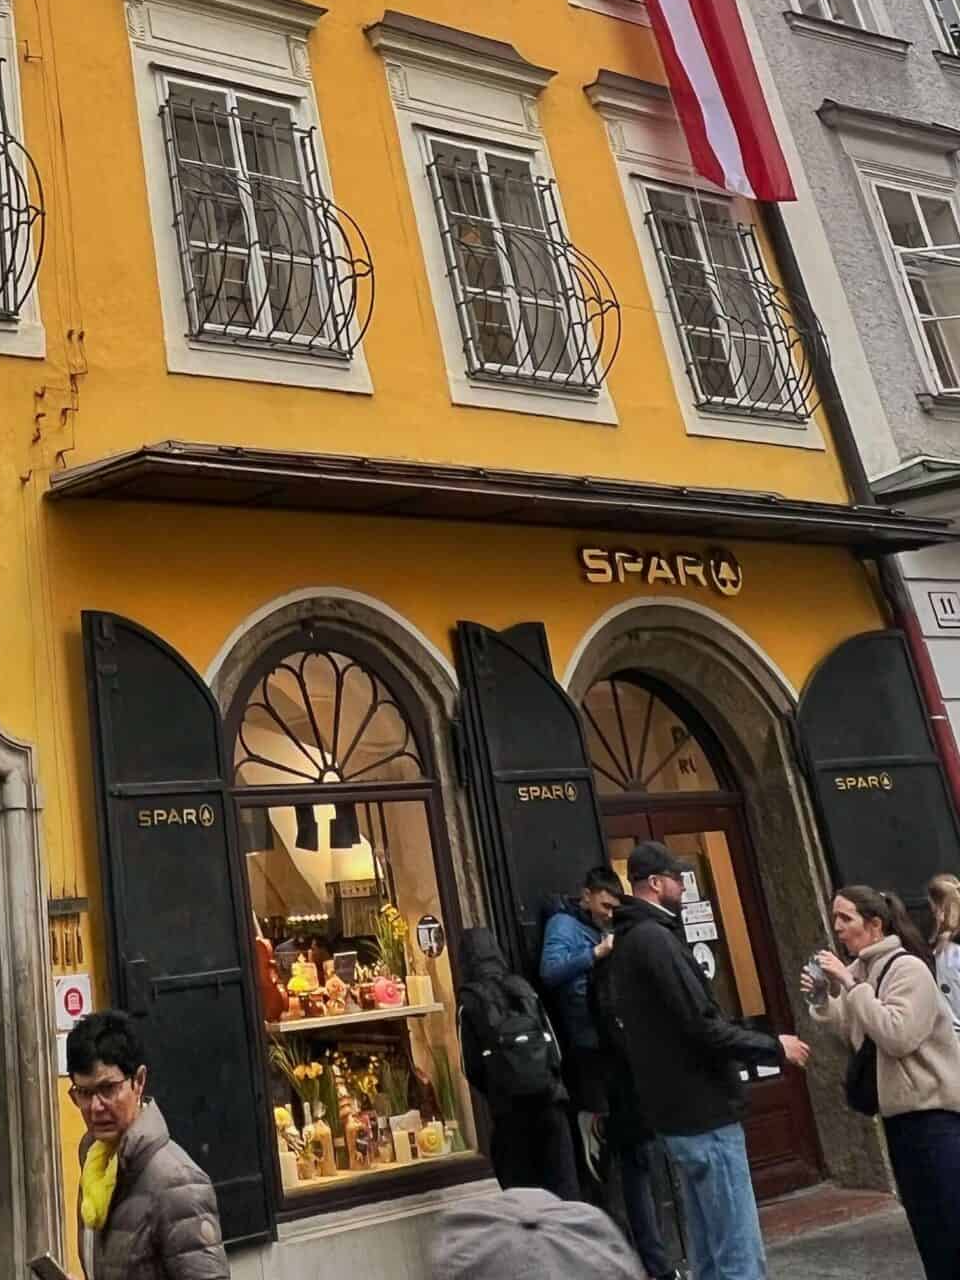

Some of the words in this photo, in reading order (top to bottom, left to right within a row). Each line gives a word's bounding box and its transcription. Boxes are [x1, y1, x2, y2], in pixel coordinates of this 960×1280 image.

[581, 548, 708, 587] SPAR
[834, 776, 881, 791] SPAR
[517, 784, 566, 802] SPAR
[138, 808, 198, 827] SPAR
